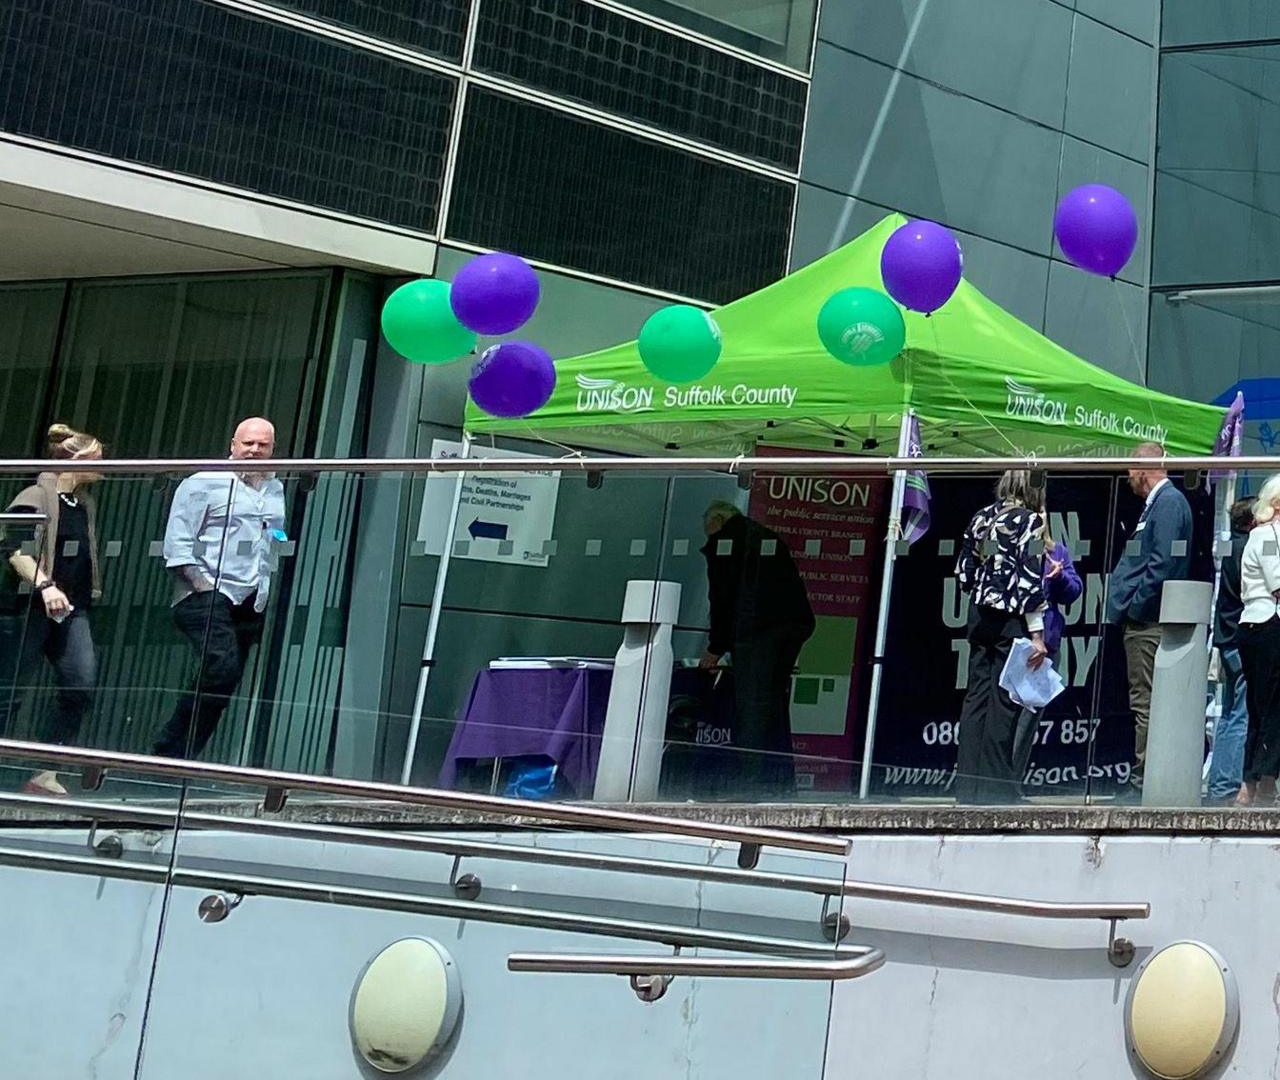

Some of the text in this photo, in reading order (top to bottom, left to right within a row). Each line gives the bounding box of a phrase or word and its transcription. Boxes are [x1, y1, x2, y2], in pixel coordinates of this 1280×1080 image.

[576, 383, 798, 412] UNISON Suffolk County
[1006, 394, 1169, 442] UNISON Suffolk County
[769, 476, 871, 508] UNISON
[1060, 720, 1101, 745] 857
